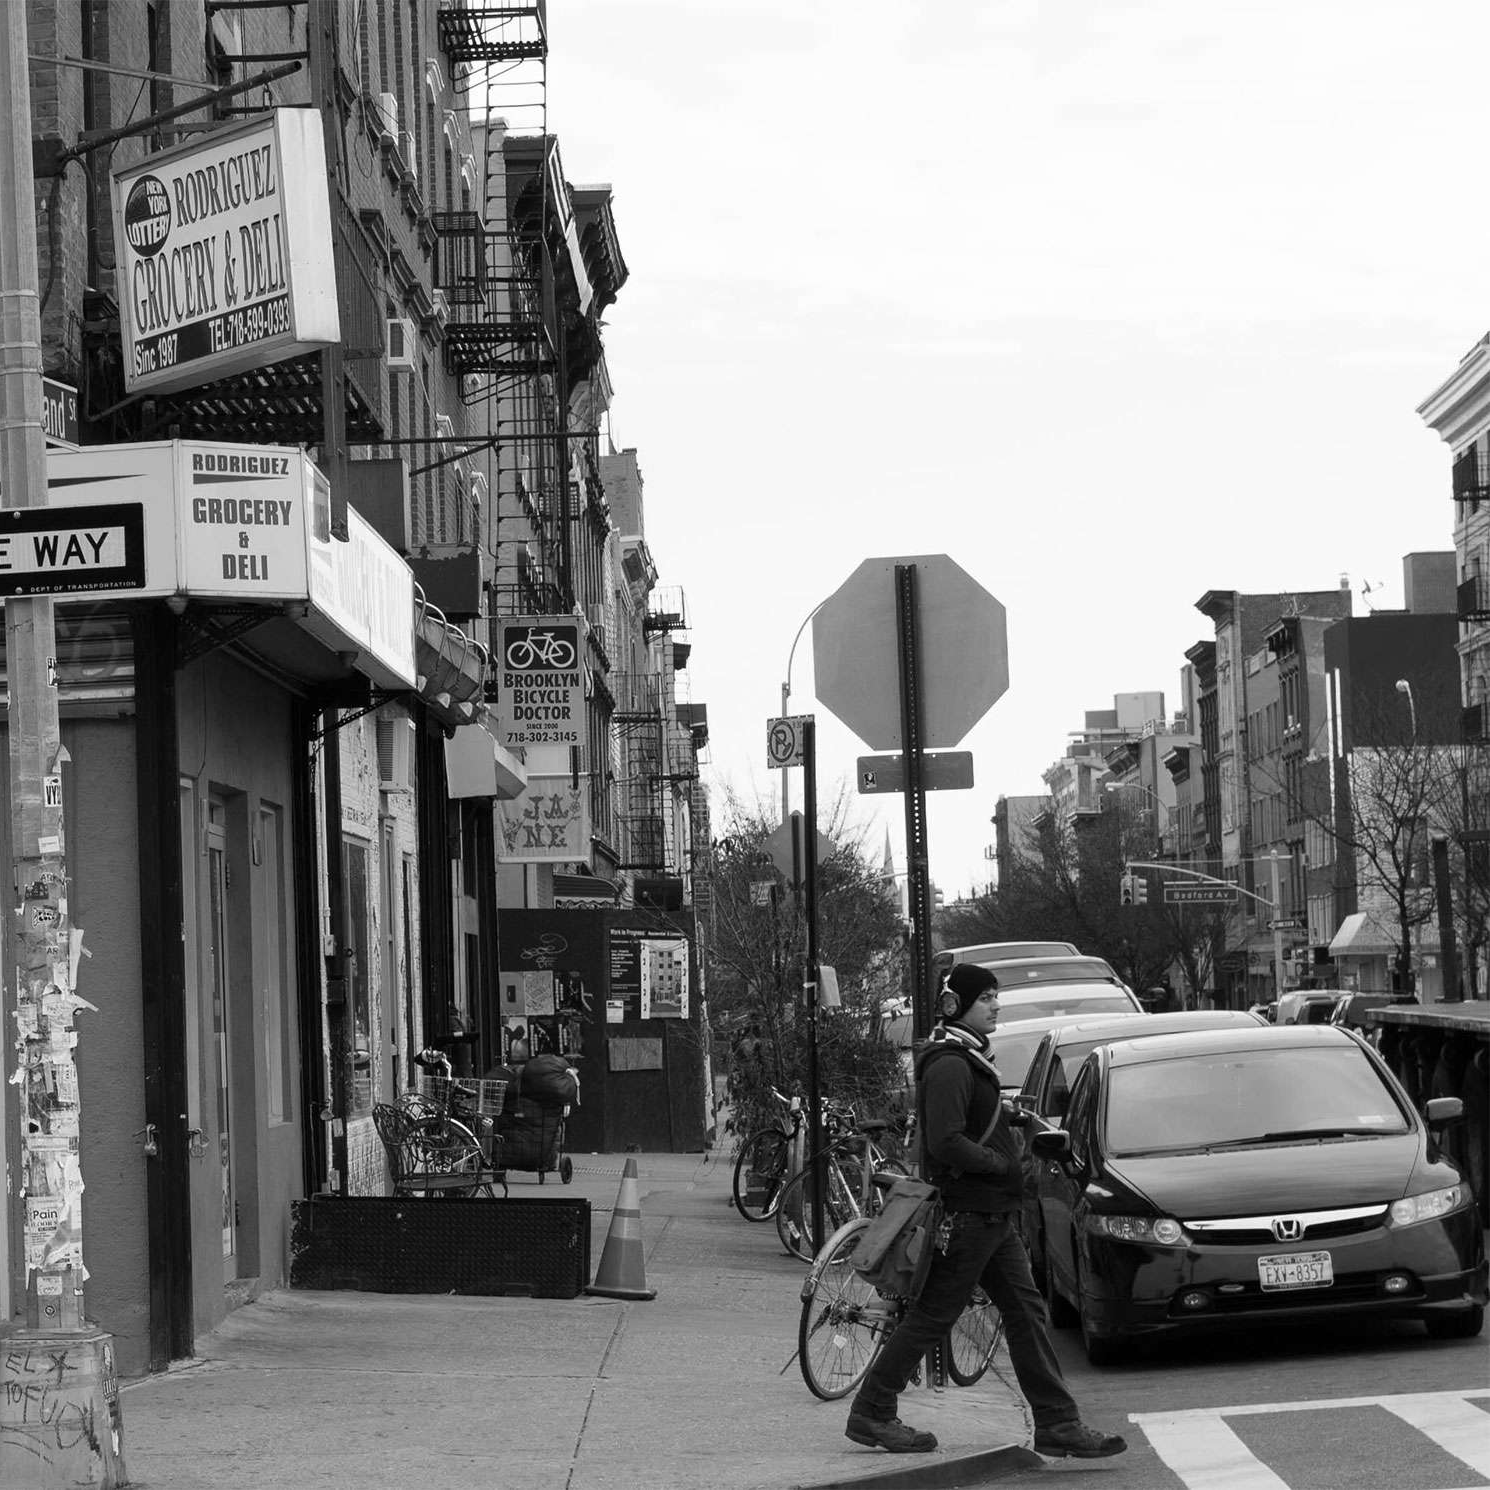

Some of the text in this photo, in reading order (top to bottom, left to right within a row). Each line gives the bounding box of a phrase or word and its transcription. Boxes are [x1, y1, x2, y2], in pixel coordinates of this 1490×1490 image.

[145, 180, 163, 195] NEW
[173, 145, 275, 228] RODRIGUEZ
[147, 196, 167, 215] YORK
[128, 213, 170, 247] LOTTERY
[133, 213, 286, 335] GROCERY & DELI
[135, 334, 178, 376] Sinc 1987
[43, 391, 77, 441] and St
[193, 453, 289, 476] RODRIGUEZ
[193, 498, 292, 525] GROCERY
[33, 531, 109, 568] WAY
[239, 531, 250, 548] &
[222, 554, 268, 580] DELI
[67, 581, 137, 591] TRANSPORTATION
[504, 673, 579, 688] BROOKLYN
[513, 689, 570, 704] BICYCLE
[513, 706, 571, 720] DOCTOR
[507, 732, 577, 743] 718-302-3145
[33, 1210, 58, 1219] Pain
